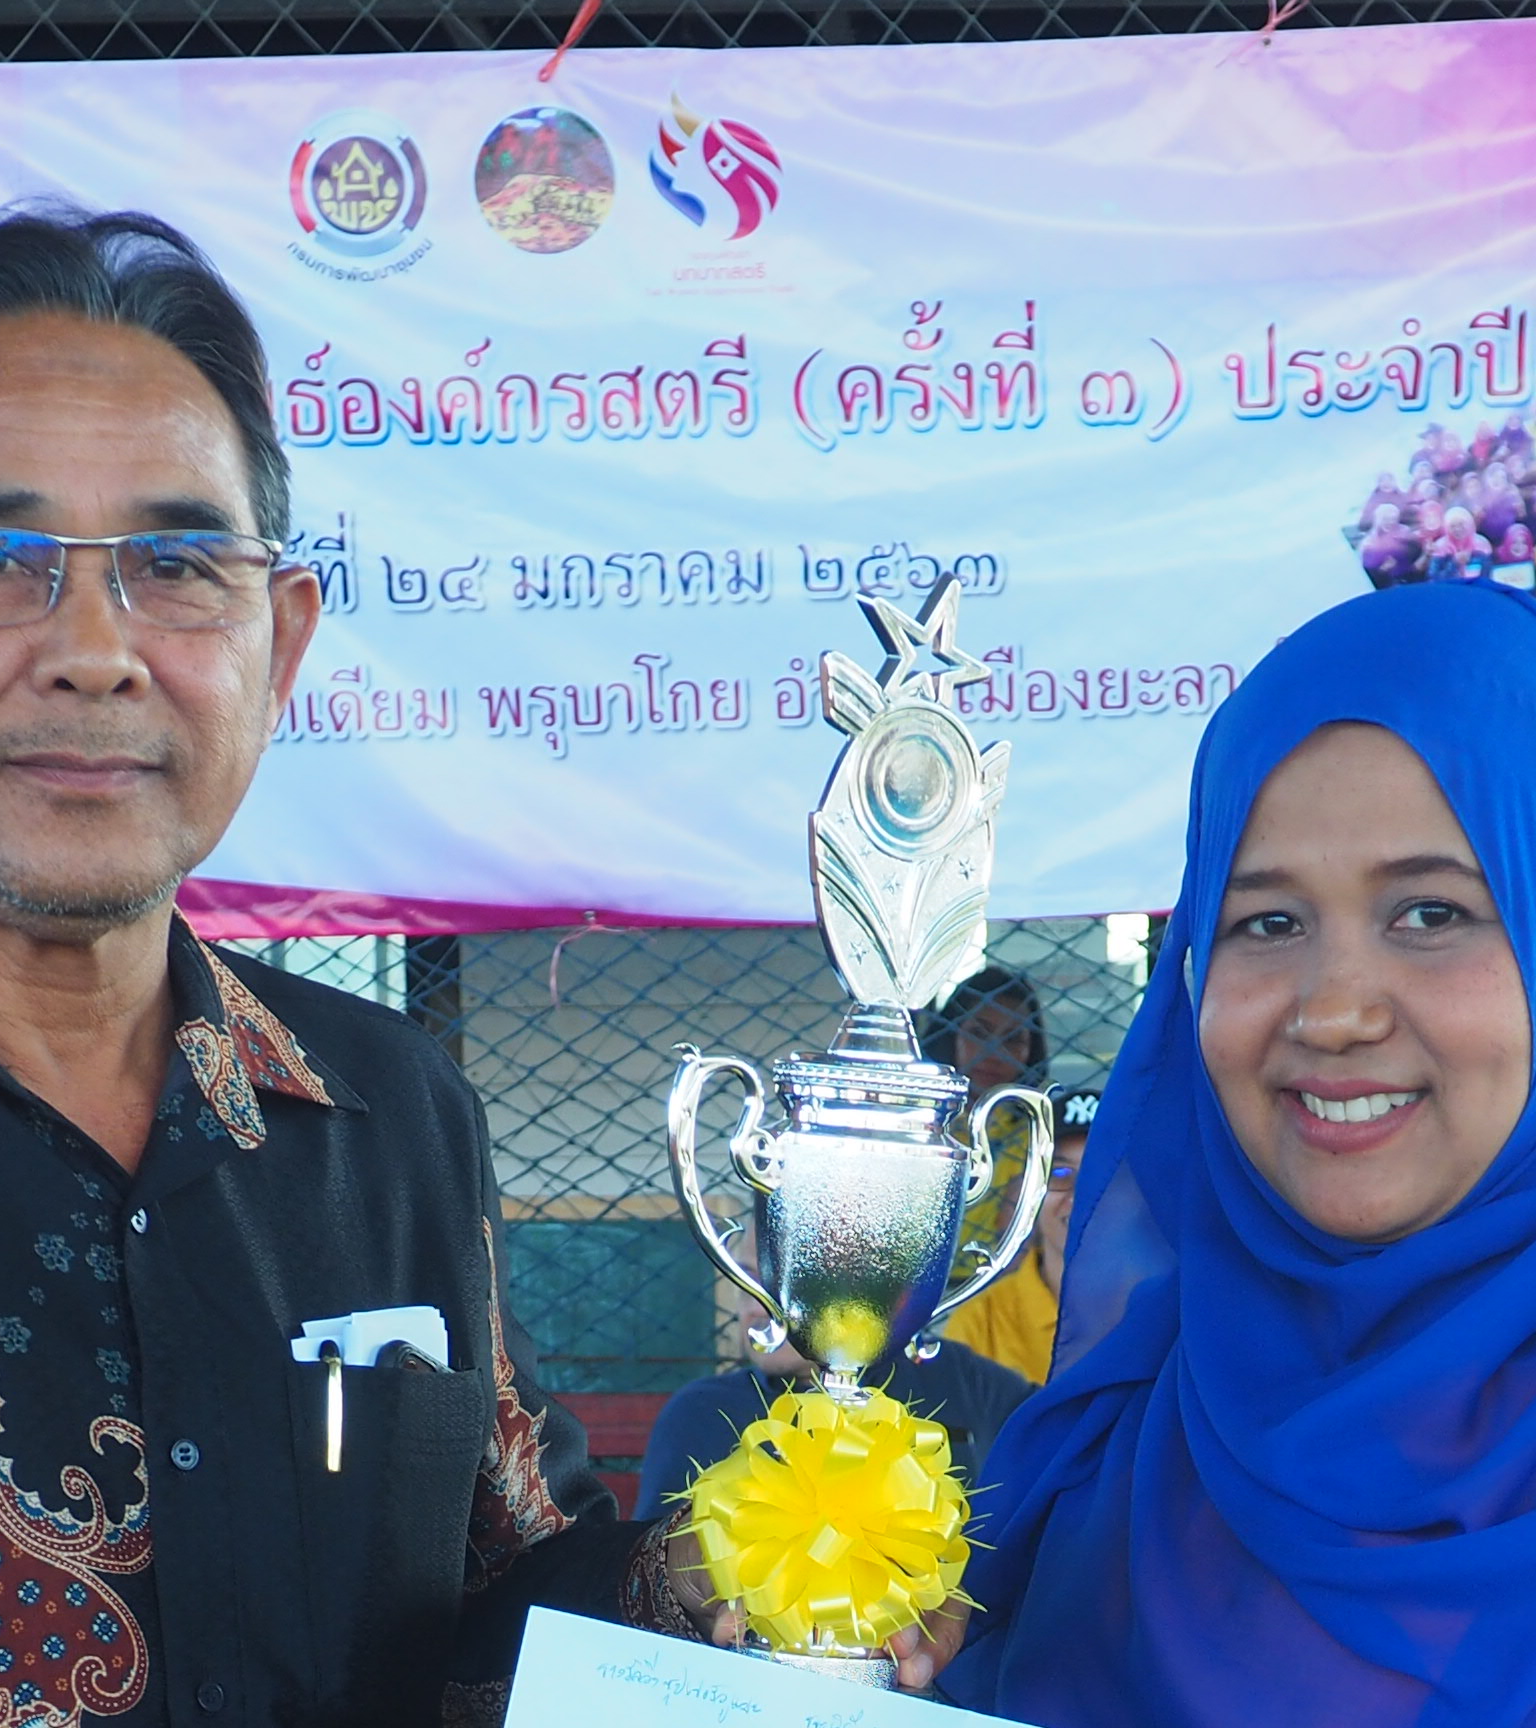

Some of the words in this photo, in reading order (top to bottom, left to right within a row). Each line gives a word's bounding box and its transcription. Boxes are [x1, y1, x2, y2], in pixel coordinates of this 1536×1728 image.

[267, 333, 750, 440] ธ์องค์กรสตรี
[794, 300, 1036, 441] (ครั้งที่
[1224, 303, 1528, 409] ประจำปี
[380, 554, 480, 604] ๒๔
[510, 546, 764, 602] มกราคม
[798, 542, 998, 592] ๒๕๖๓
[478, 656, 748, 752] พรุบาโกย
